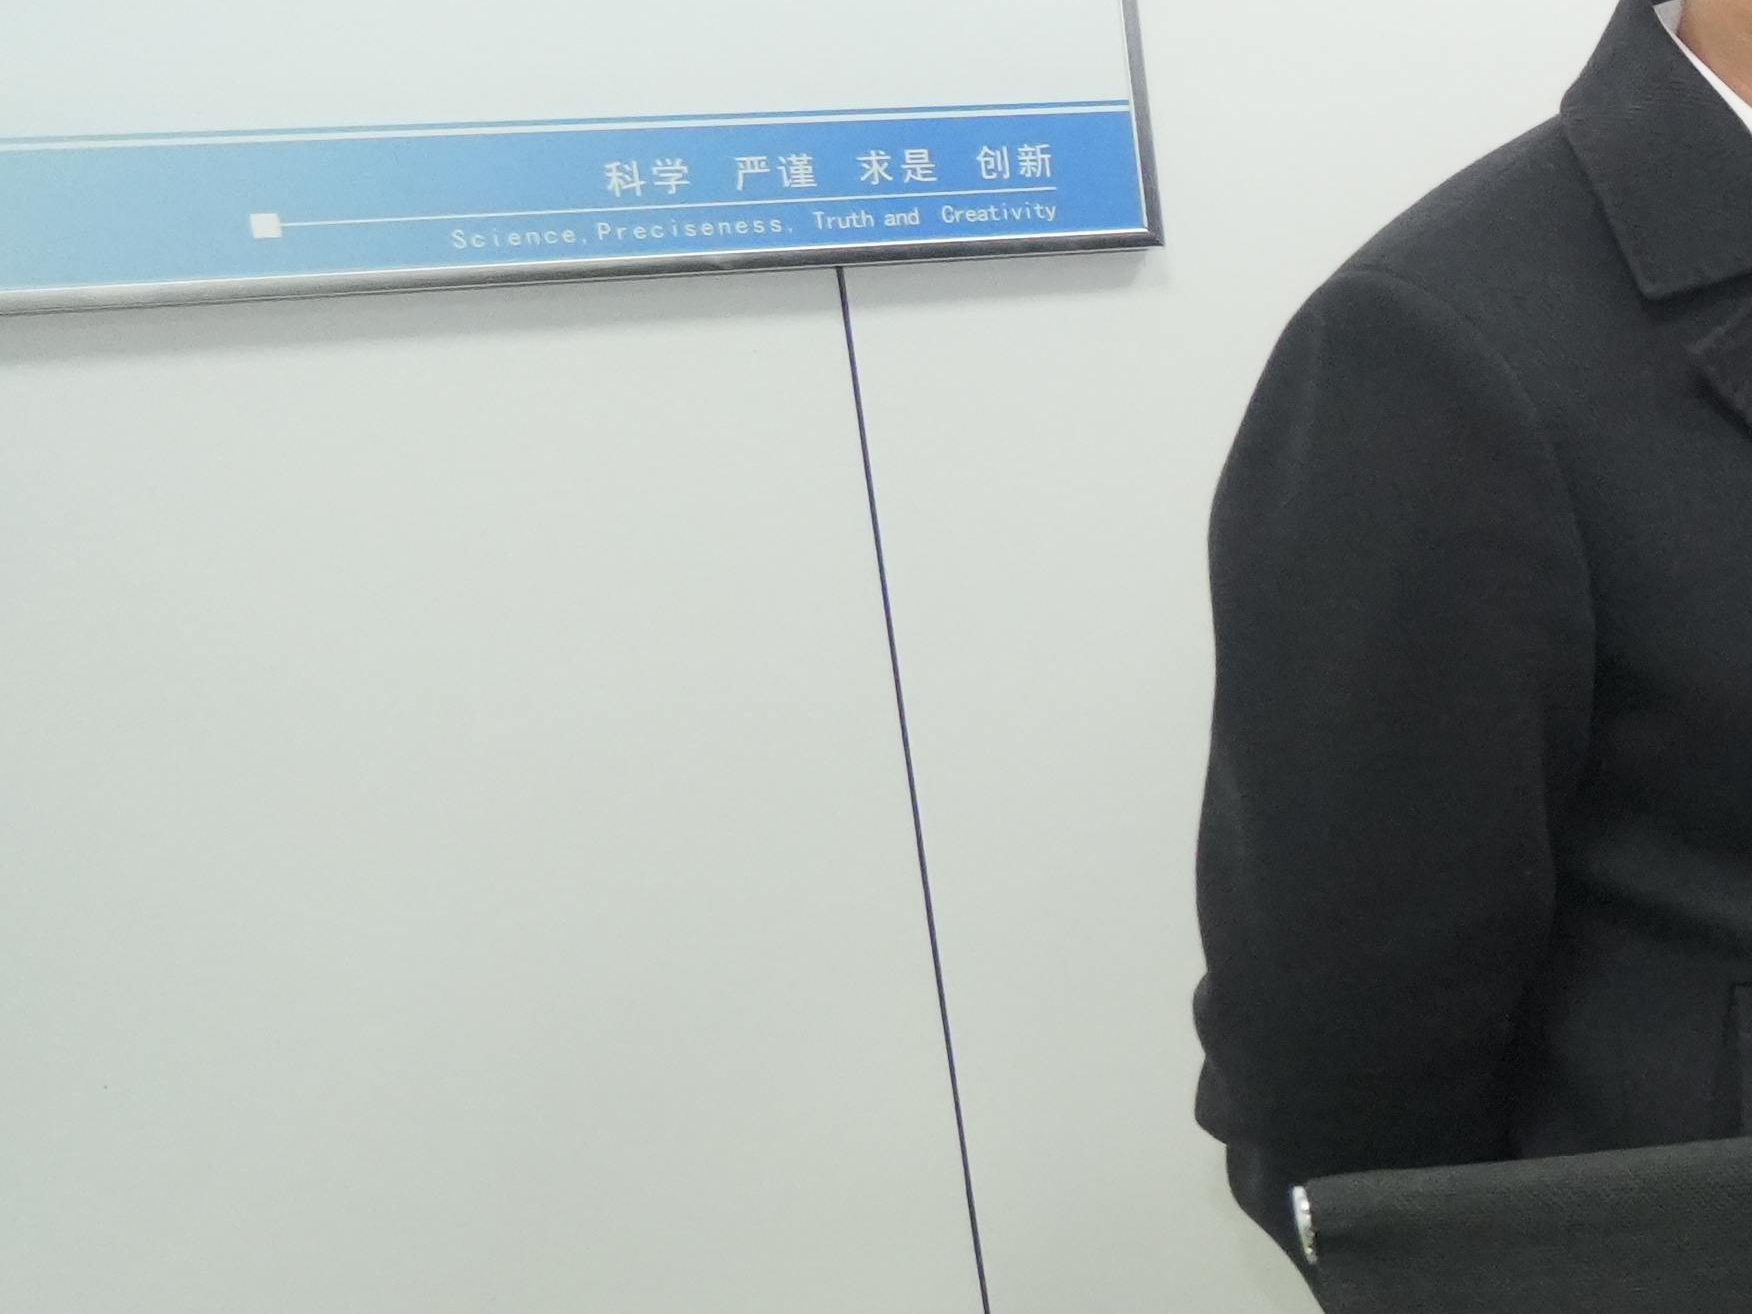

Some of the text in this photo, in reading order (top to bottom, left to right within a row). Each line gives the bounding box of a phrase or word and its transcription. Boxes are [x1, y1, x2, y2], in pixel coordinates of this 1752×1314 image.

[604, 142, 1054, 198] 科学 严谨 求是 创新
[813, 209, 875, 230] Truth
[883, 206, 920, 228] and
[941, 200, 1057, 224] Creativity
